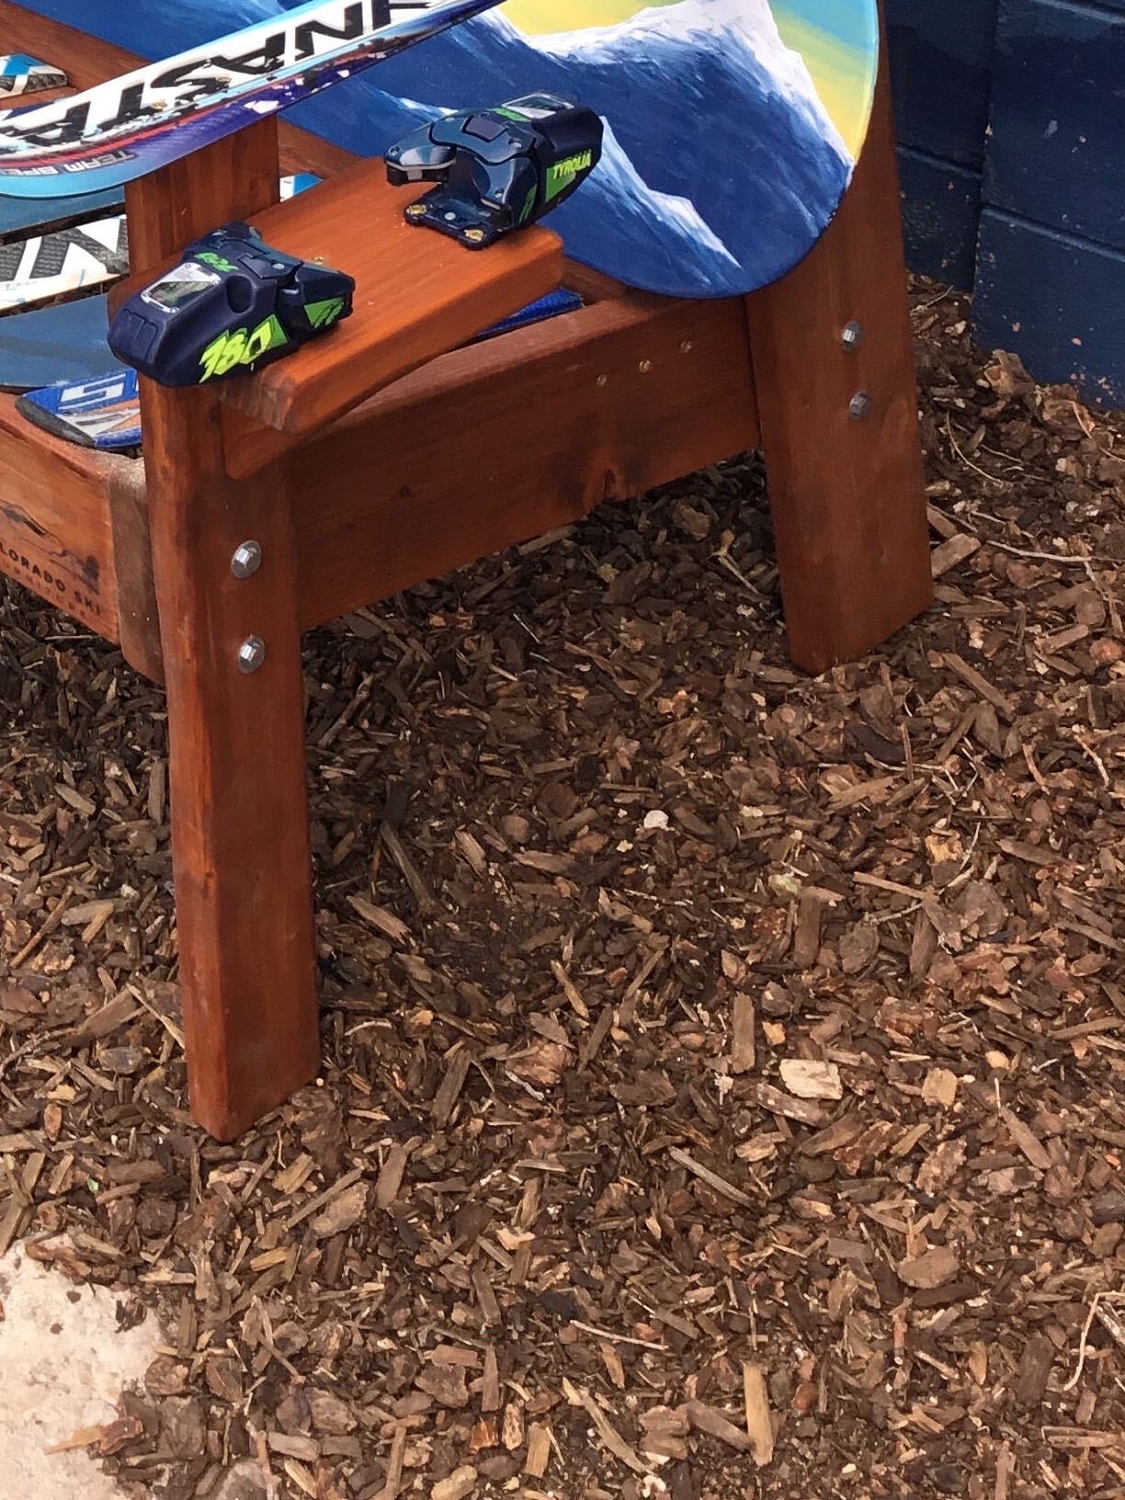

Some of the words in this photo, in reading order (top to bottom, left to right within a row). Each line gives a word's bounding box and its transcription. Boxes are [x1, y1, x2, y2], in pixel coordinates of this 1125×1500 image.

[65, 150, 135, 174] TEAM
[552, 150, 592, 180] TYROLIA
[74, 590, 101, 616] SKI
